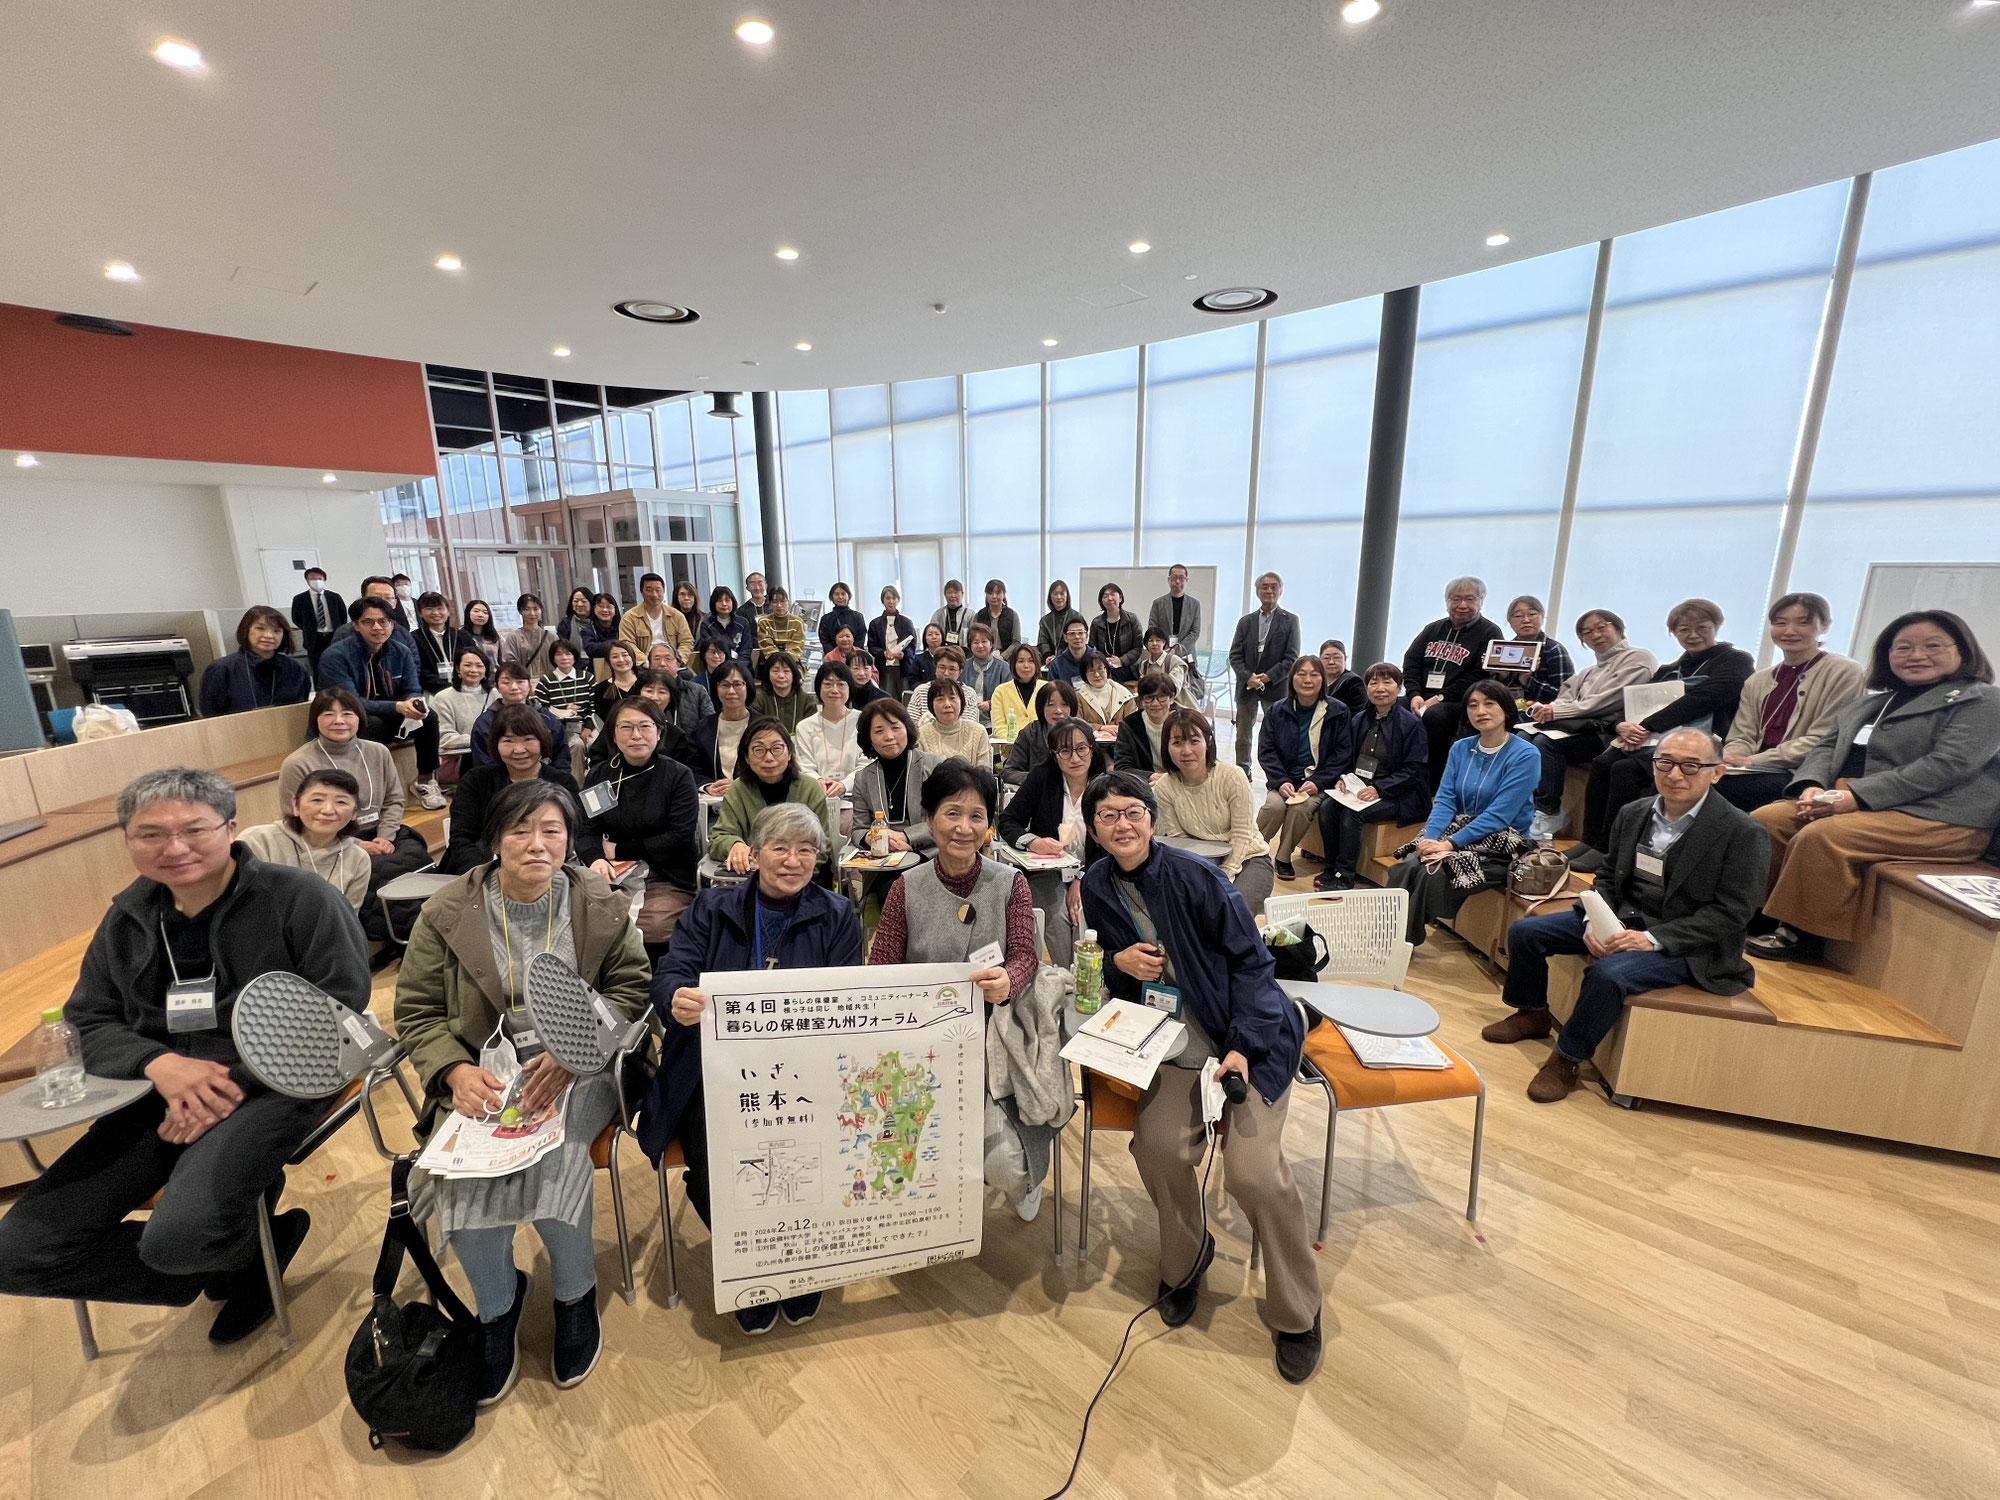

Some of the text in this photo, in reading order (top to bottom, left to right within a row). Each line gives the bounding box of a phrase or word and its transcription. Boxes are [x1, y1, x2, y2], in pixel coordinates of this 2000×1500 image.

[861, 992, 929, 1001] コミュニティーナース
[725, 1000, 776, 1014] 第4回
[727, 1012, 918, 1032] 暮らしの保健室九州フォーラム
[740, 1090, 813, 1113] 熊本へ
